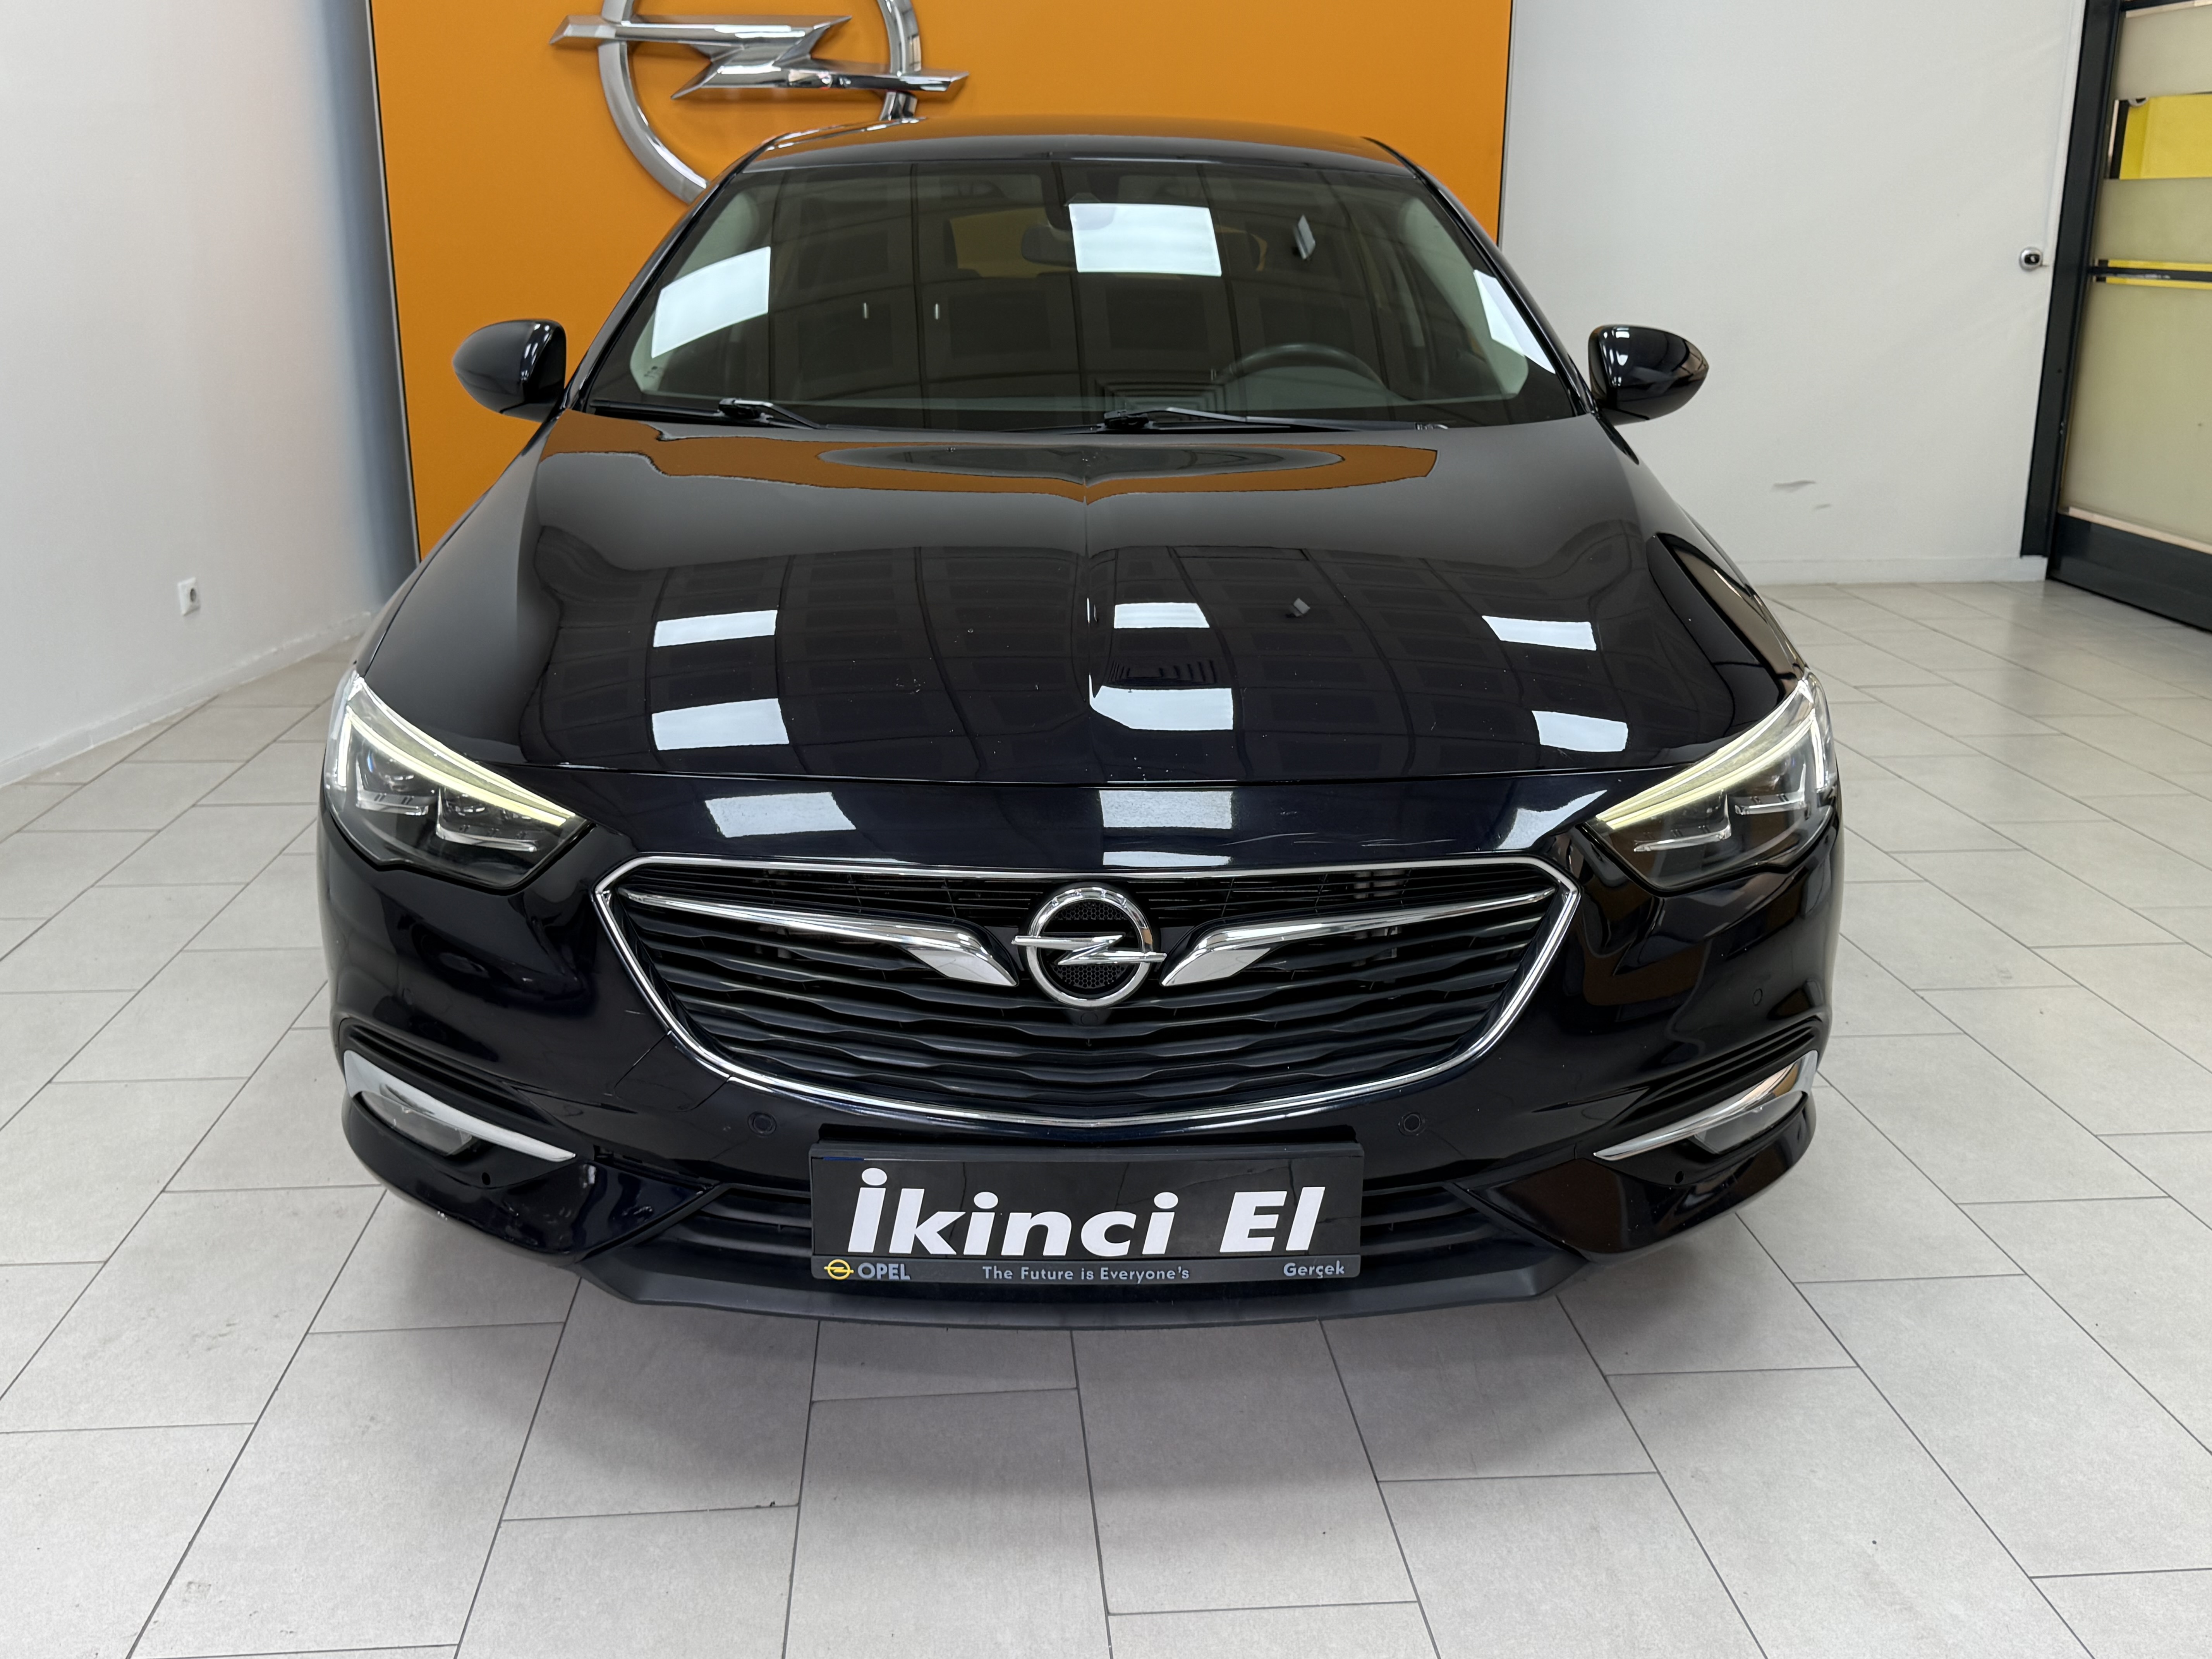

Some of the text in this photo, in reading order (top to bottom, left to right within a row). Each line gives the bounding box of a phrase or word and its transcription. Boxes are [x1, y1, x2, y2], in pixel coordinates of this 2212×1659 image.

[847, 1168, 1326, 1257] İkinci El
[857, 1262, 911, 1280] OPEL
[982, 1265, 1013, 1279] The
[1021, 1267, 1073, 1280] Future
[1081, 1268, 1094, 1280] is
[1283, 1260, 1345, 1279] Gerçek
